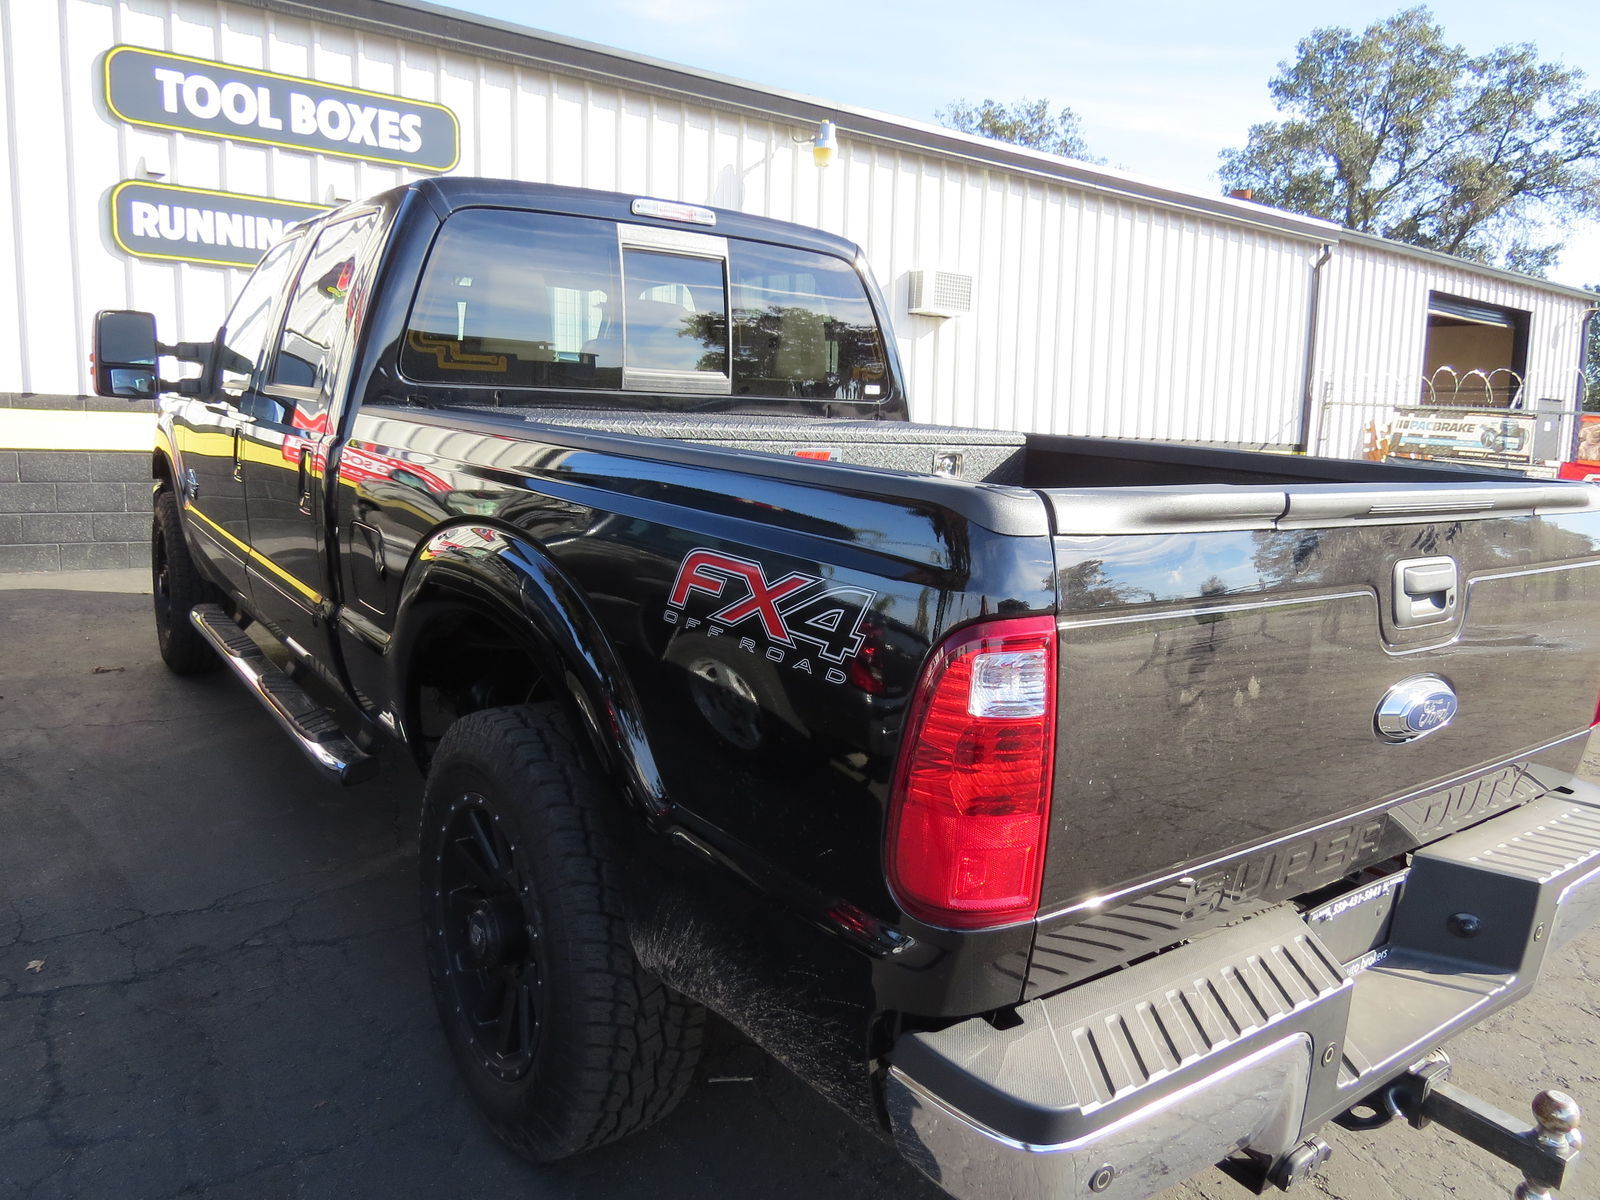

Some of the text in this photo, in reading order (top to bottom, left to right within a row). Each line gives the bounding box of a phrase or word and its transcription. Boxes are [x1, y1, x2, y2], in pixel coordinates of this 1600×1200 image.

[155, 67, 422, 153] TOOL BOXES
[1408, 420, 1476, 434] PACBRAKE
[667, 547, 877, 665] FX4
[663, 609, 847, 685] OFF ROAD
[1418, 699, 1451, 728] Ford
[1180, 763, 1531, 923] SUPER DUTY
